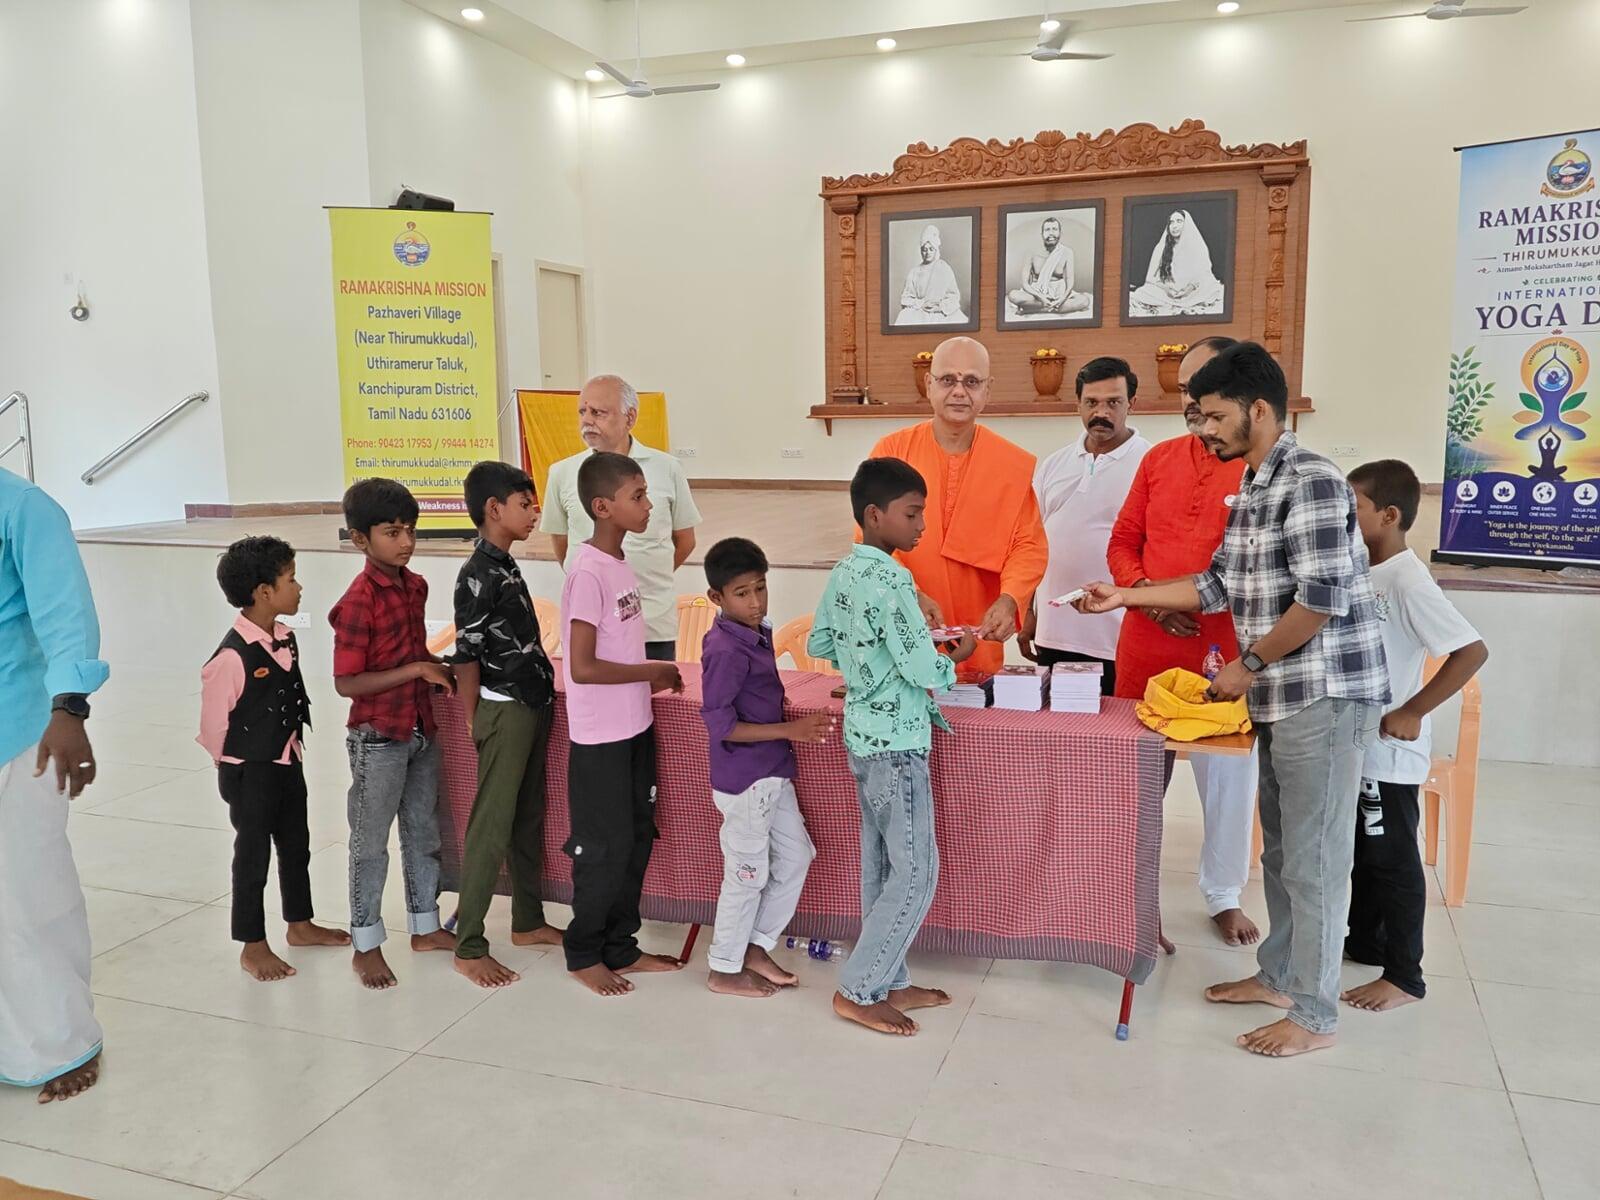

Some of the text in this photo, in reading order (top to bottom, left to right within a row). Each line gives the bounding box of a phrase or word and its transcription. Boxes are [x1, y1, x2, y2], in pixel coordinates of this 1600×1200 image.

[1533, 275, 1593, 285] CELEBRATING
[340, 280, 486, 297] RAMAKRISHNA MISSION
[1497, 285, 1600, 301] INTERNATIO
[368, 305, 462, 323] Pazhaveri Village
[1475, 302, 1568, 330] YOGA
[355, 329, 478, 349] (Near Thirumukkudal),
[366, 357, 468, 373] Uthiramerur Taluk,
[358, 382, 478, 398] Kanchipuram District,
[368, 407, 472, 420] Tamil Nadu 631606
[347, 438, 494, 450] Phone: 90423 17953 / 99444 14274
[355, 457, 380, 468] Email:
[417, 500, 460, 510] Weakness
[1507, 520, 1514, 529] is
[1515, 522, 1528, 530] the
[1529, 522, 1559, 533] journey
[1561, 523, 1571, 531] of
[1571, 524, 1585, 532] the
[1489, 529, 1519, 539] through
[1520, 531, 1533, 539] the
[1561, 533, 1575, 542] the
[1508, 540, 1531, 548] Swami
[1532, 542, 1574, 551] Vivekananda
